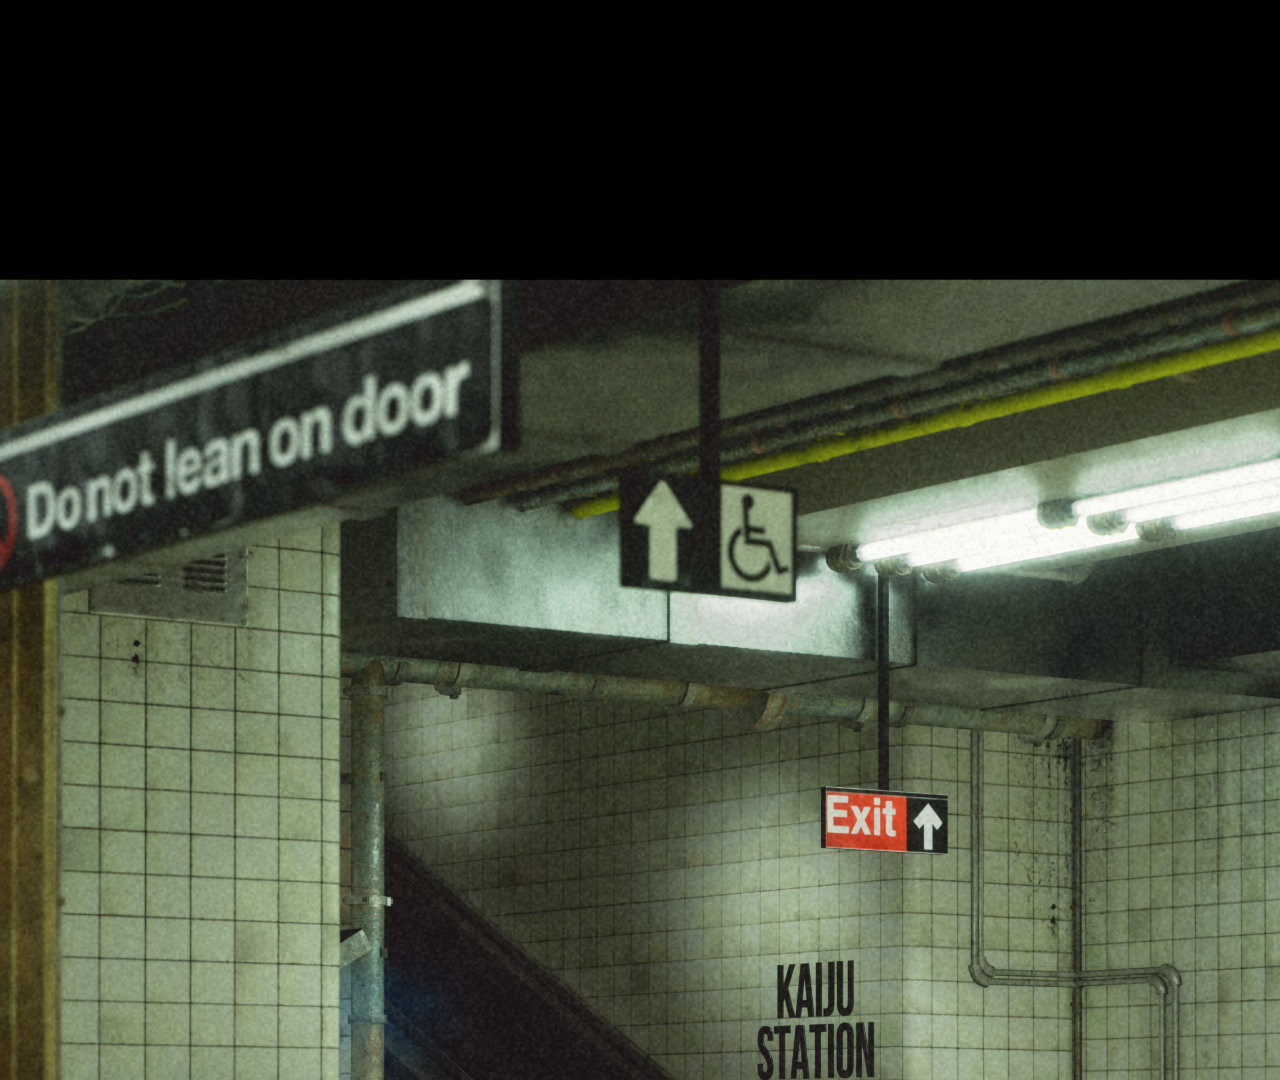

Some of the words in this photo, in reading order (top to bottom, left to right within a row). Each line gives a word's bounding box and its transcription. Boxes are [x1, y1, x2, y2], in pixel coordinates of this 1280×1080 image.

[25, 480, 83, 541] Do
[85, 449, 156, 525] not
[164, 428, 262, 501] lean
[268, 404, 333, 469] on
[341, 359, 472, 448] door
[825, 794, 897, 838] Exit
[777, 960, 855, 1019] KAIJU
[757, 1021, 875, 1080] STATION
